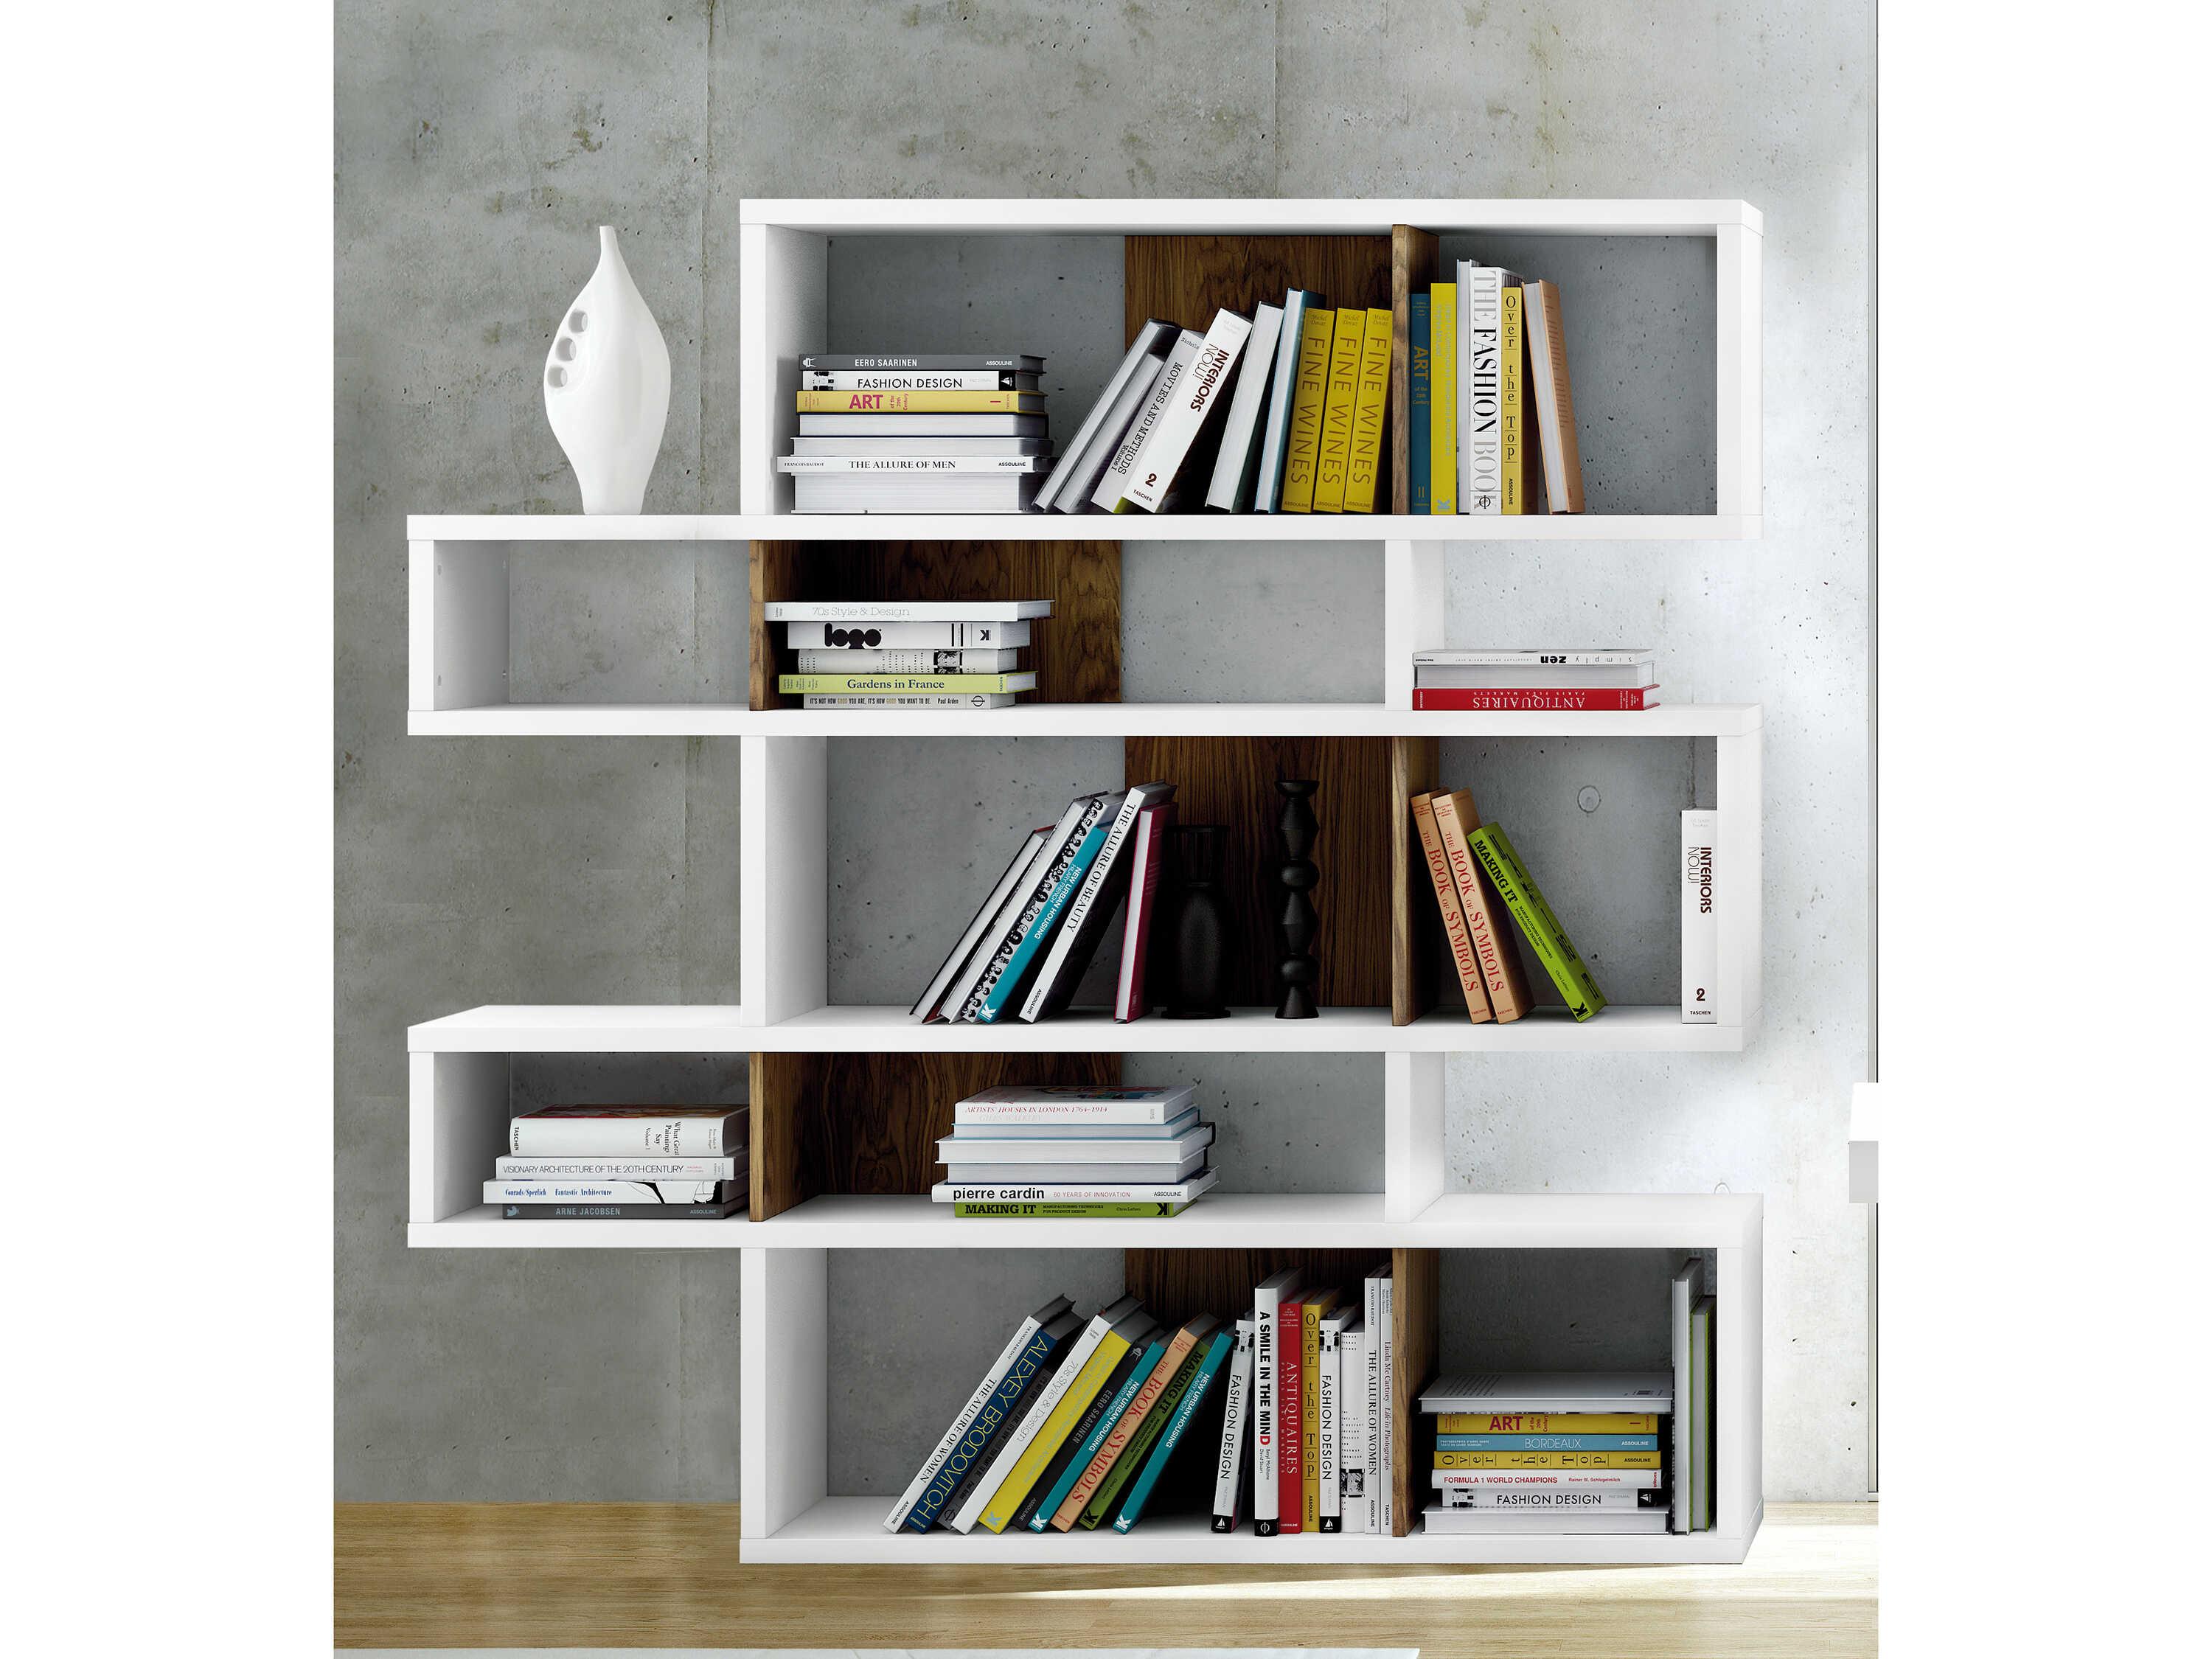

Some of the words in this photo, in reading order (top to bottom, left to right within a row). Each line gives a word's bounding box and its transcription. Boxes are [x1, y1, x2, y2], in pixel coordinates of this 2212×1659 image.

[1475, 271, 1496, 321] THE
[1192, 343, 1218, 380] NOW!
[1301, 337, 1325, 391] FINE
[1333, 336, 1357, 391] FINE
[1363, 336, 1386, 391] FINE
[1414, 346, 1428, 380] ART
[858, 379, 911, 388] FASHION
[917, 379, 961, 388] DESIGN
[1154, 361, 1183, 404] MOVIES
[1189, 349, 1229, 412] INTERIORS
[1473, 327, 1497, 434] FASHION
[849, 394, 883, 409] ART
[1141, 402, 1161, 427] AND
[1116, 425, 1148, 475] METHODS
[1290, 403, 1317, 484] WINES
[1322, 403, 1349, 484] WINES
[1352, 403, 1378, 484] WINES
[849, 461, 870, 469] THE
[873, 461, 914, 469] ALLURE
[917, 461, 931, 469] OF
[933, 461, 956, 469] MEN
[1144, 473, 1157, 487] 2
[1133, 489, 1152, 501] TASCHEN
[832, 608, 858, 617] Style
[871, 608, 910, 617] Design
[824, 623, 882, 649] logo
[848, 679, 891, 689] Gardens
[894, 679, 905, 688] in
[908, 680, 944, 688] France
[1473, 695, 1585, 708] ANTIQUAIRES
[1117, 801, 1135, 827] THE
[1096, 826, 1123, 870] ALLURE
[1422, 830, 1432, 847] THE
[1444, 831, 1454, 847] THE
[1062, 863, 1075, 882] HILARY
[1068, 866, 1081, 884] NEW
[1088, 869, 1102, 886] OF
[1427, 848, 1452, 895] BOOK
[1450, 848, 1475, 896] BOOK
[1473, 838, 1509, 891] MAKING
[1503, 888, 1517, 904] IT
[1688, 847, 1700, 883] NOW!
[1049, 880, 1065, 903] FRENCH
[1700, 847, 1711, 913] INTERIORS
[1053, 883, 1071, 908] URBAN
[1441, 898, 1449, 910] OF
[1465, 899, 1473, 910] OF
[1065, 886, 1093, 932] BEAUTY
[1034, 906, 1057, 940] HOUSING
[1444, 910, 1478, 992] SYMBOLS
[1468, 911, 1504, 992] SYMBOLS
[1026, 988, 1043, 1015] ASSOULINE
[1696, 988, 1705, 1001] 2
[654, 1134, 662, 1144] Say
[664, 1124, 672, 1152] Paintings
[504, 1165, 538, 1173] VISIONARY
[540, 1165, 594, 1173] ARCHITECTURE
[595, 1165, 604, 1173] OF
[606, 1165, 622, 1173] THE
[624, 1165, 644, 1173] 20TH
[646, 1165, 684, 1173] CENTURY
[954, 1188, 995, 1200] pierre
[1000, 1188, 1044, 1199] cardin
[966, 1205, 1019, 1214] MAKING
[1023, 1205, 1036, 1214] IT
[1260, 1311, 1270, 1320] A
[1260, 1324, 1270, 1363] SMILE
[994, 1335, 1051, 1408] ALEXEY
[1062, 1360, 1079, 1377] 70s
[1155, 1359, 1169, 1376] THE
[1166, 1350, 1203, 1400] MAKING
[1191, 1371, 1205, 1389] HILARY
[1260, 1367, 1270, 1380] IN
[1385, 1363, 1391, 1374] Mc
[978, 1376, 997, 1398] THE
[1044, 1374, 1068, 1402] Style
[1119, 1377, 1134, 1397] HILARY
[1124, 1380, 1139, 1398] NEW
[1197, 1373, 1210, 1391] NEW
[1040, 1398, 1052, 1411] &
[1096, 1388, 1113, 1409] EERO
[1105, 1395, 1122, 1417] FRENCH
[1127, 1376, 1163, 1421] BOOK
[1157, 1398, 1172, 1414] IT
[1178, 1389, 1194, 1411] FRENCH
[1183, 1390, 1200, 1416] URBAN
[1225, 1374, 1241, 1428] FASHION
[1259, 1384, 1270, 1407] THE
[1322, 1375, 1332, 1429] FASHION
[953, 1396, 983, 1433] ALLURE
[1108, 1397, 1128, 1422] URBAN
[1284, 1362, 1297, 1474] ANTIQUAIRES
[1015, 1407, 1045, 1444] Design
[1071, 1407, 1100, 1444] SAARINEN
[1088, 1419, 1112, 1452] HOUSING
[1119, 1418, 1129, 1429] OF
[1165, 1415, 1186, 1447] HOUSING
[1259, 1411, 1270, 1445] MIND
[1368, 1418, 1376, 1432] OF
[1489, 1416, 1523, 1430] ART
[944, 1432, 958, 1447] OF
[1525, 1439, 1581, 1449] BORDEAUX
[917, 1403, 1003, 1520] BRODOVITCH
[919, 1445, 948, 1483] WOMEN
[1071, 1429, 1126, 1504] SYMBOLS
[1220, 1433, 1234, 1479] DESIGN
[1322, 1434, 1332, 1479] DESIGN
[1498, 1495, 1551, 1504] FASHION
[1557, 1495, 1601, 1504] DESIGN
[891, 1500, 909, 1525] ASSOULINE
